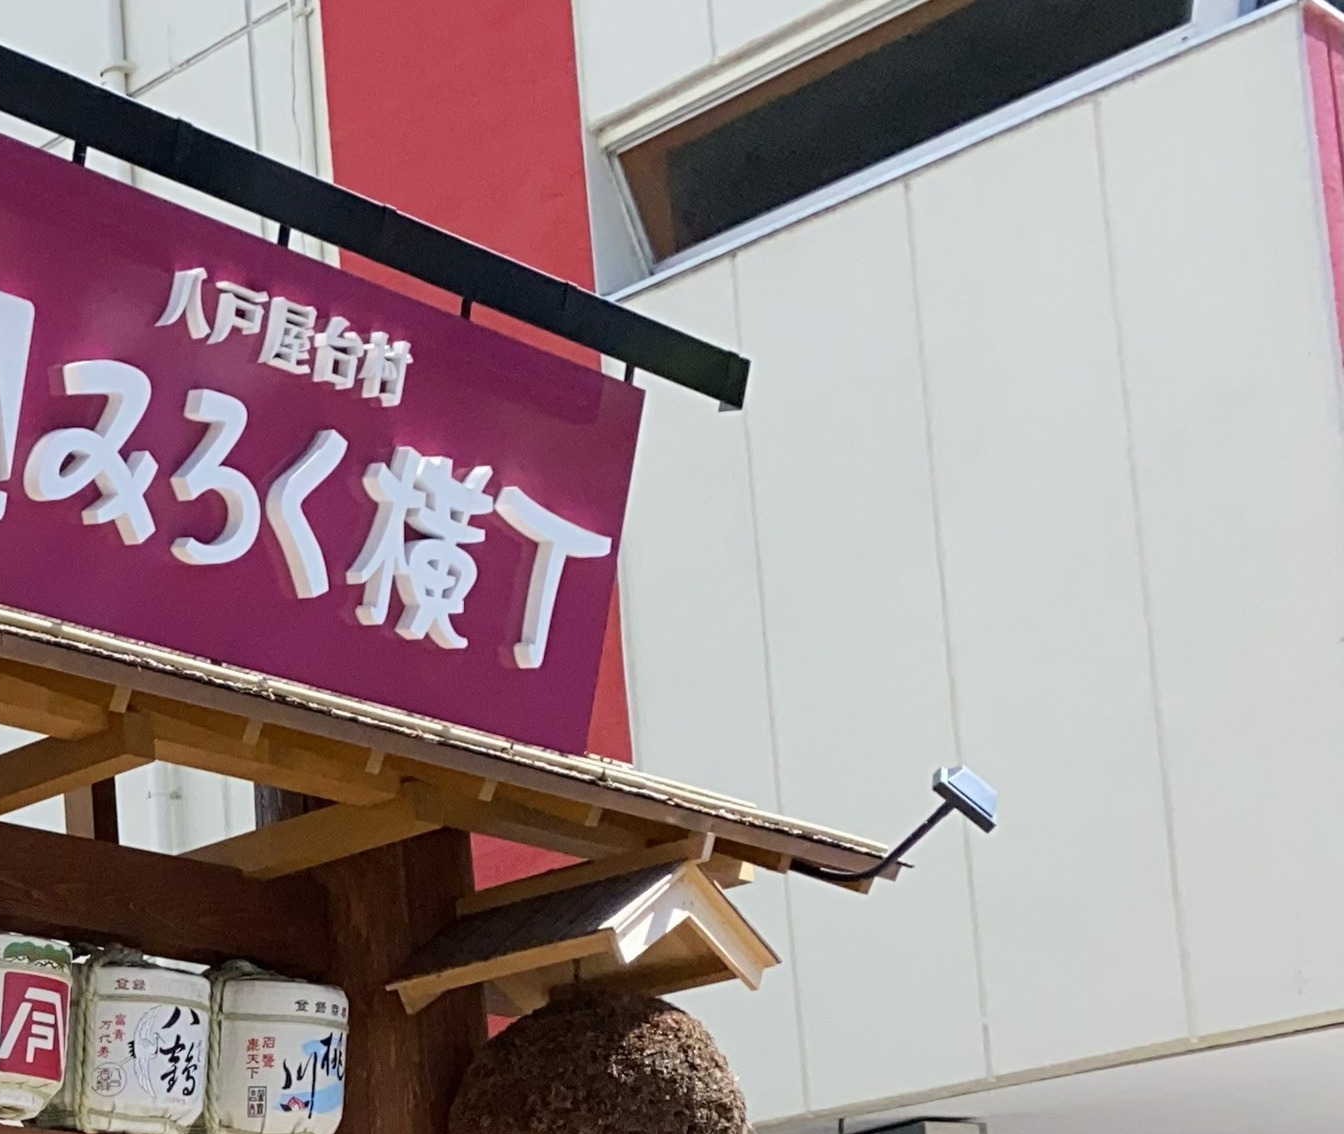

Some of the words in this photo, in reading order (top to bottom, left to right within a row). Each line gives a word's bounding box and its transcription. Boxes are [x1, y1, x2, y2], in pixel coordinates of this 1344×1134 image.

[155, 266, 413, 408] 八戸屋台村
[24, 358, 613, 671] みろく横丁
